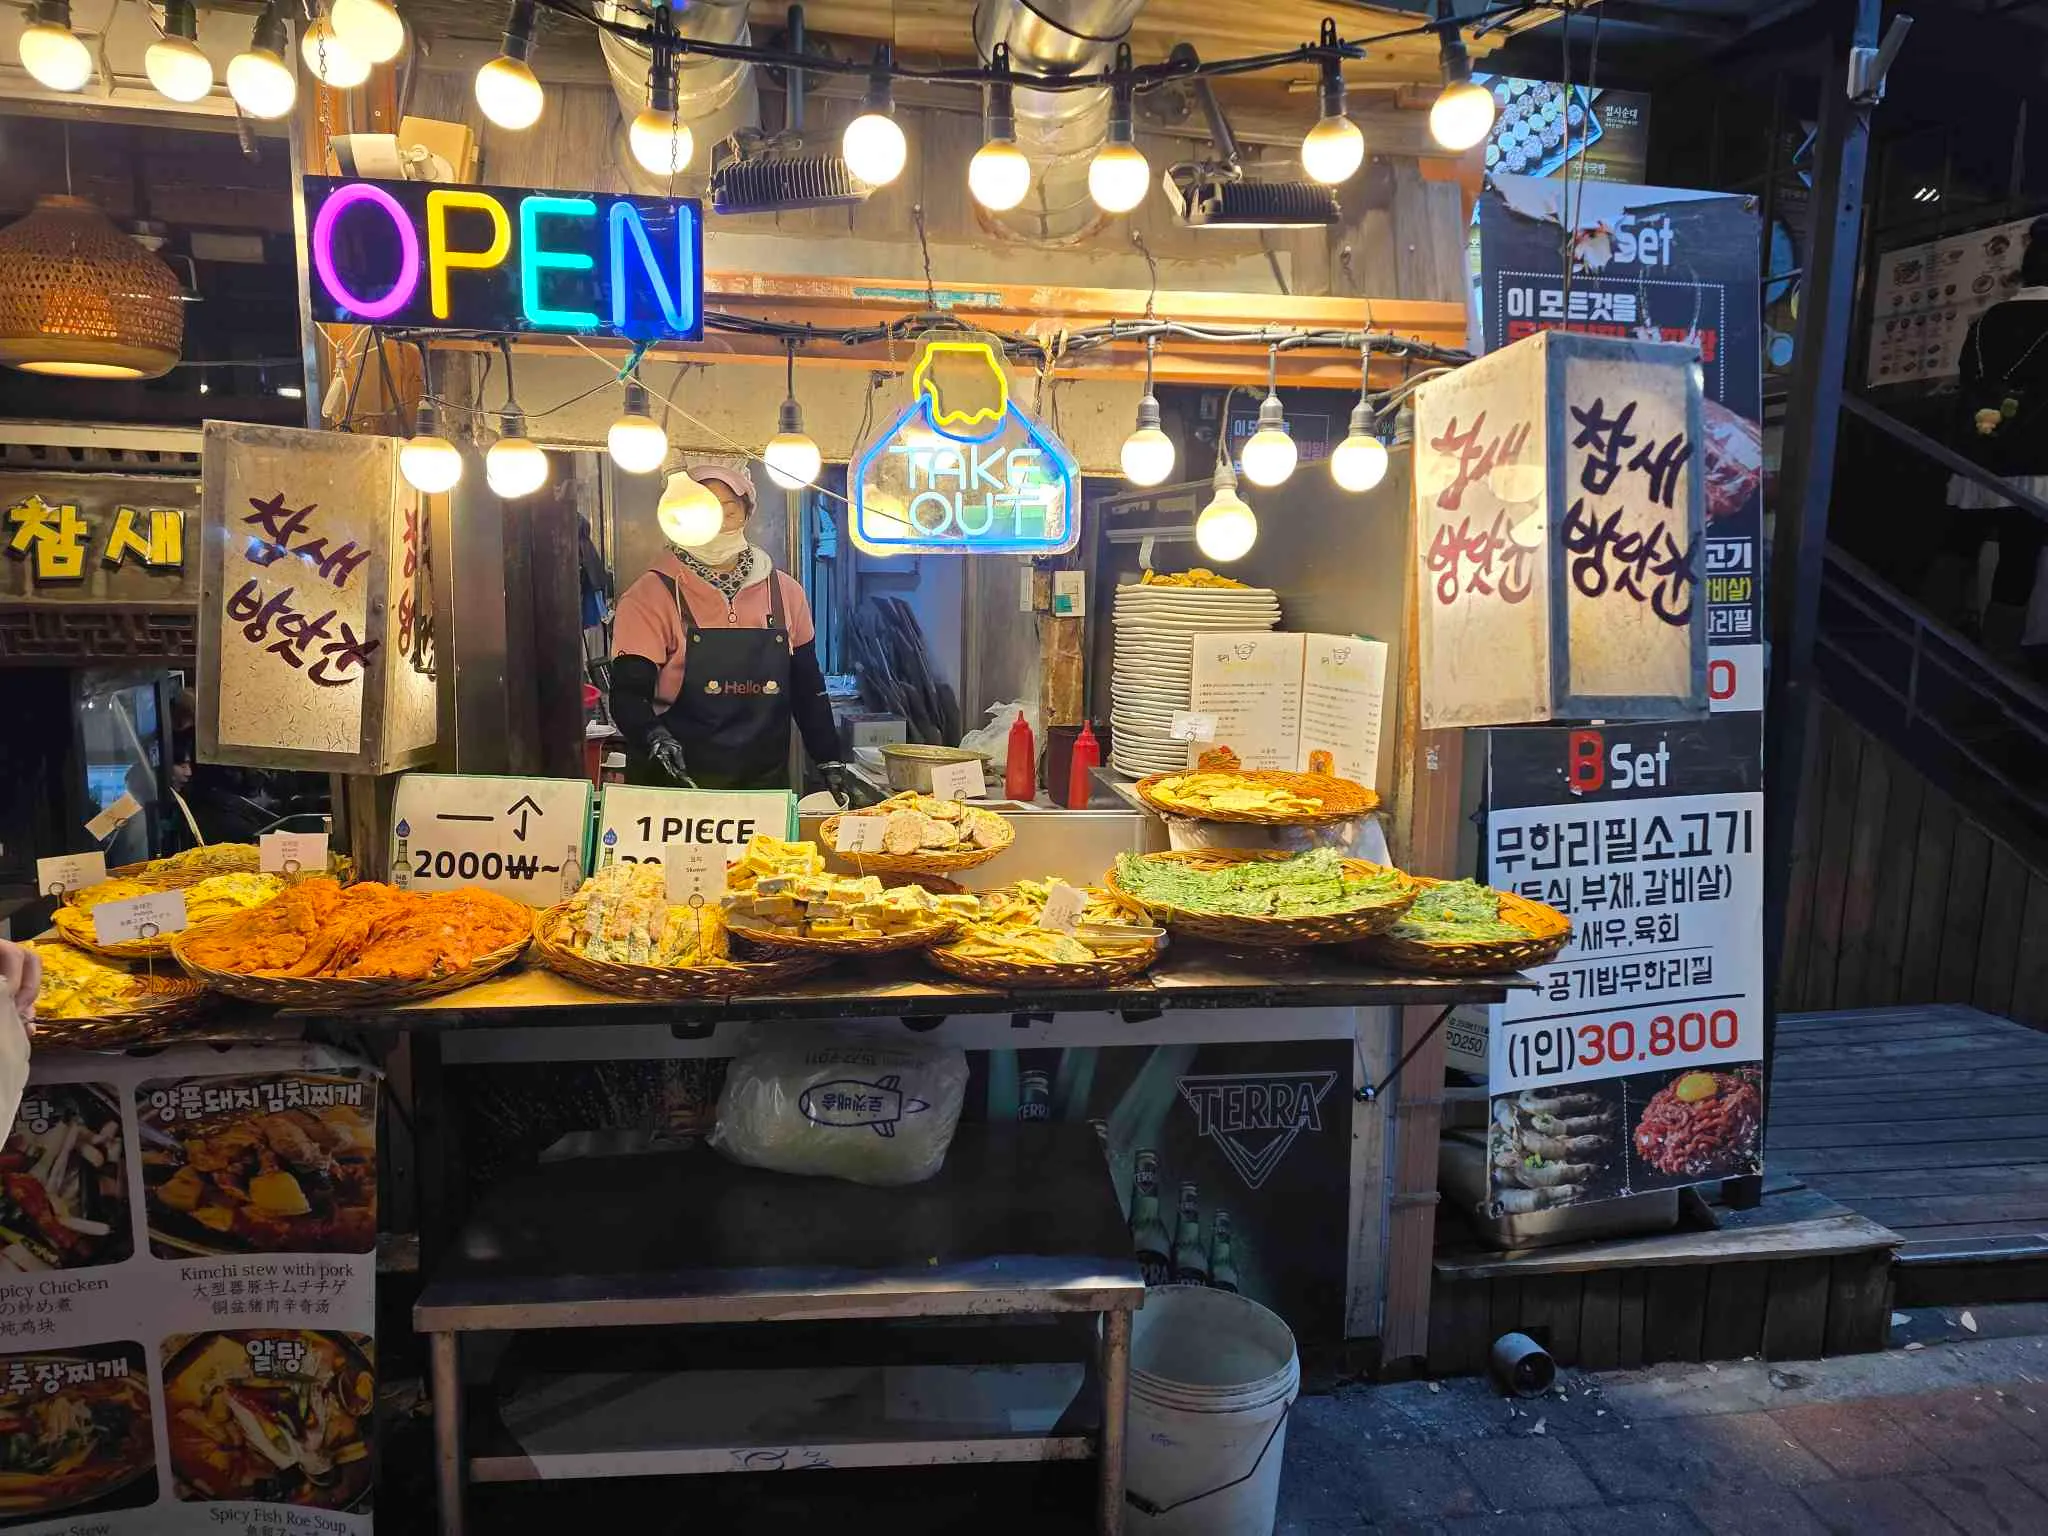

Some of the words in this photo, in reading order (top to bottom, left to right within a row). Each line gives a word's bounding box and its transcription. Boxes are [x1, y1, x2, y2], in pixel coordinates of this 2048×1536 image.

[313, 183, 695, 332] OPEN
[1507, 287, 1534, 317] 이
[1539, 290, 1637, 322] 모든것을
[889, 444, 1041, 492] TAKE
[910, 494, 1041, 537] OUT
[8, 494, 186, 581] 참새
[724, 679, 761, 695] Hello
[1569, 731, 1604, 791] B
[1611, 741, 1670, 790] Set
[661, 817, 756, 845] PIECE
[1495, 810, 1752, 873] 무한리필소고기
[20, 1099, 55, 1134] 탕
[1187, 1082, 1323, 1136] TERRA
[40, 1278, 110, 1296] Chicken
[181, 1263, 237, 1282] Kimchi
[242, 1263, 278, 1277] stew
[283, 1263, 315, 1277] with
[318, 1263, 354, 1281] pork
[246, 1340, 306, 1374] 알탕
[0, 1357, 129, 1396] 추장찌개
[209, 1508, 251, 1524] Spicy
[255, 1507, 283, 1525] Fish
[287, 1510, 312, 1527] Roe
[314, 1514, 347, 1534] Soup
